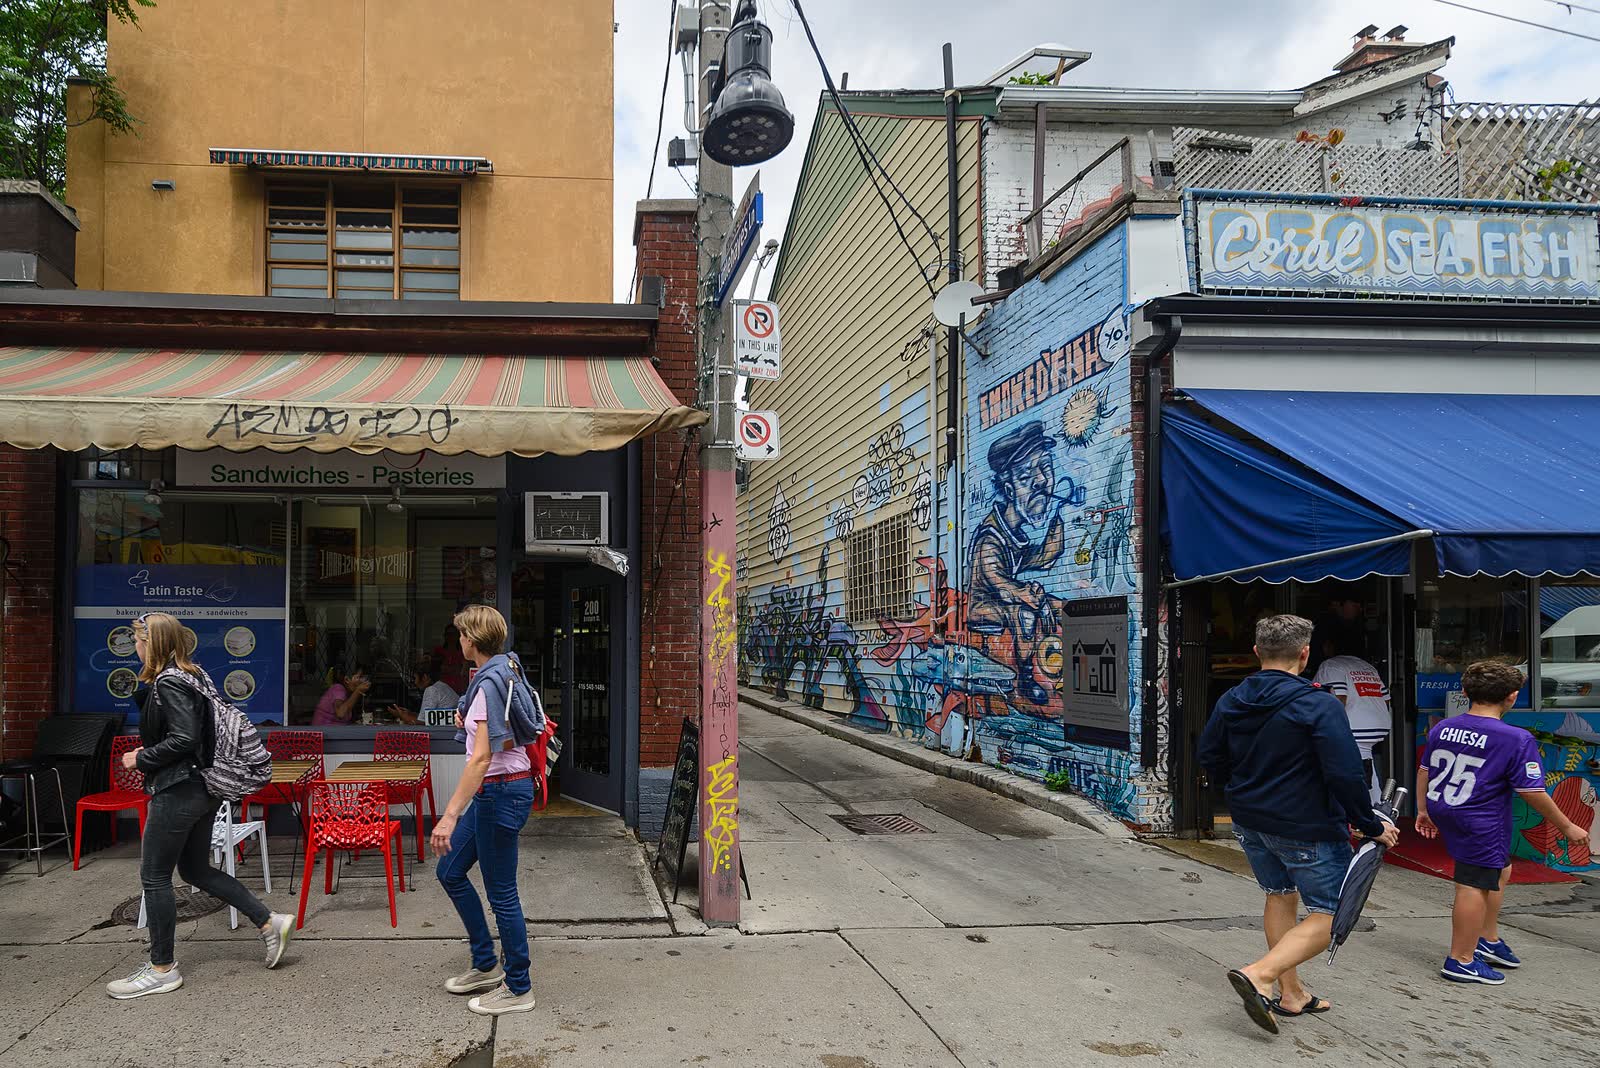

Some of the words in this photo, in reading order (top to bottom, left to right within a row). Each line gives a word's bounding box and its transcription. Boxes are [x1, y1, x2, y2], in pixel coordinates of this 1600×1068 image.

[1213, 214, 1366, 275] Coral
[1386, 227, 1467, 277] SEA
[1482, 230, 1580, 279] FISH
[1337, 276, 1401, 288] MARKET
[739, 339, 746, 348] IN
[748, 340, 761, 350] THIS
[763, 342, 778, 353] LANE
[210, 464, 349, 485] Sandwiches
[372, 465, 475, 486] Pasteries
[143, 585, 171, 596] Latin
[174, 585, 203, 596] Taste
[116, 608, 141, 617] bakery
[206, 608, 248, 616] sandwiches
[584, 600, 599, 616] 200
[1420, 681, 1450, 690] FRESH
[1439, 727, 1488, 750] CHIESA
[1426, 748, 1487, 807] 25
